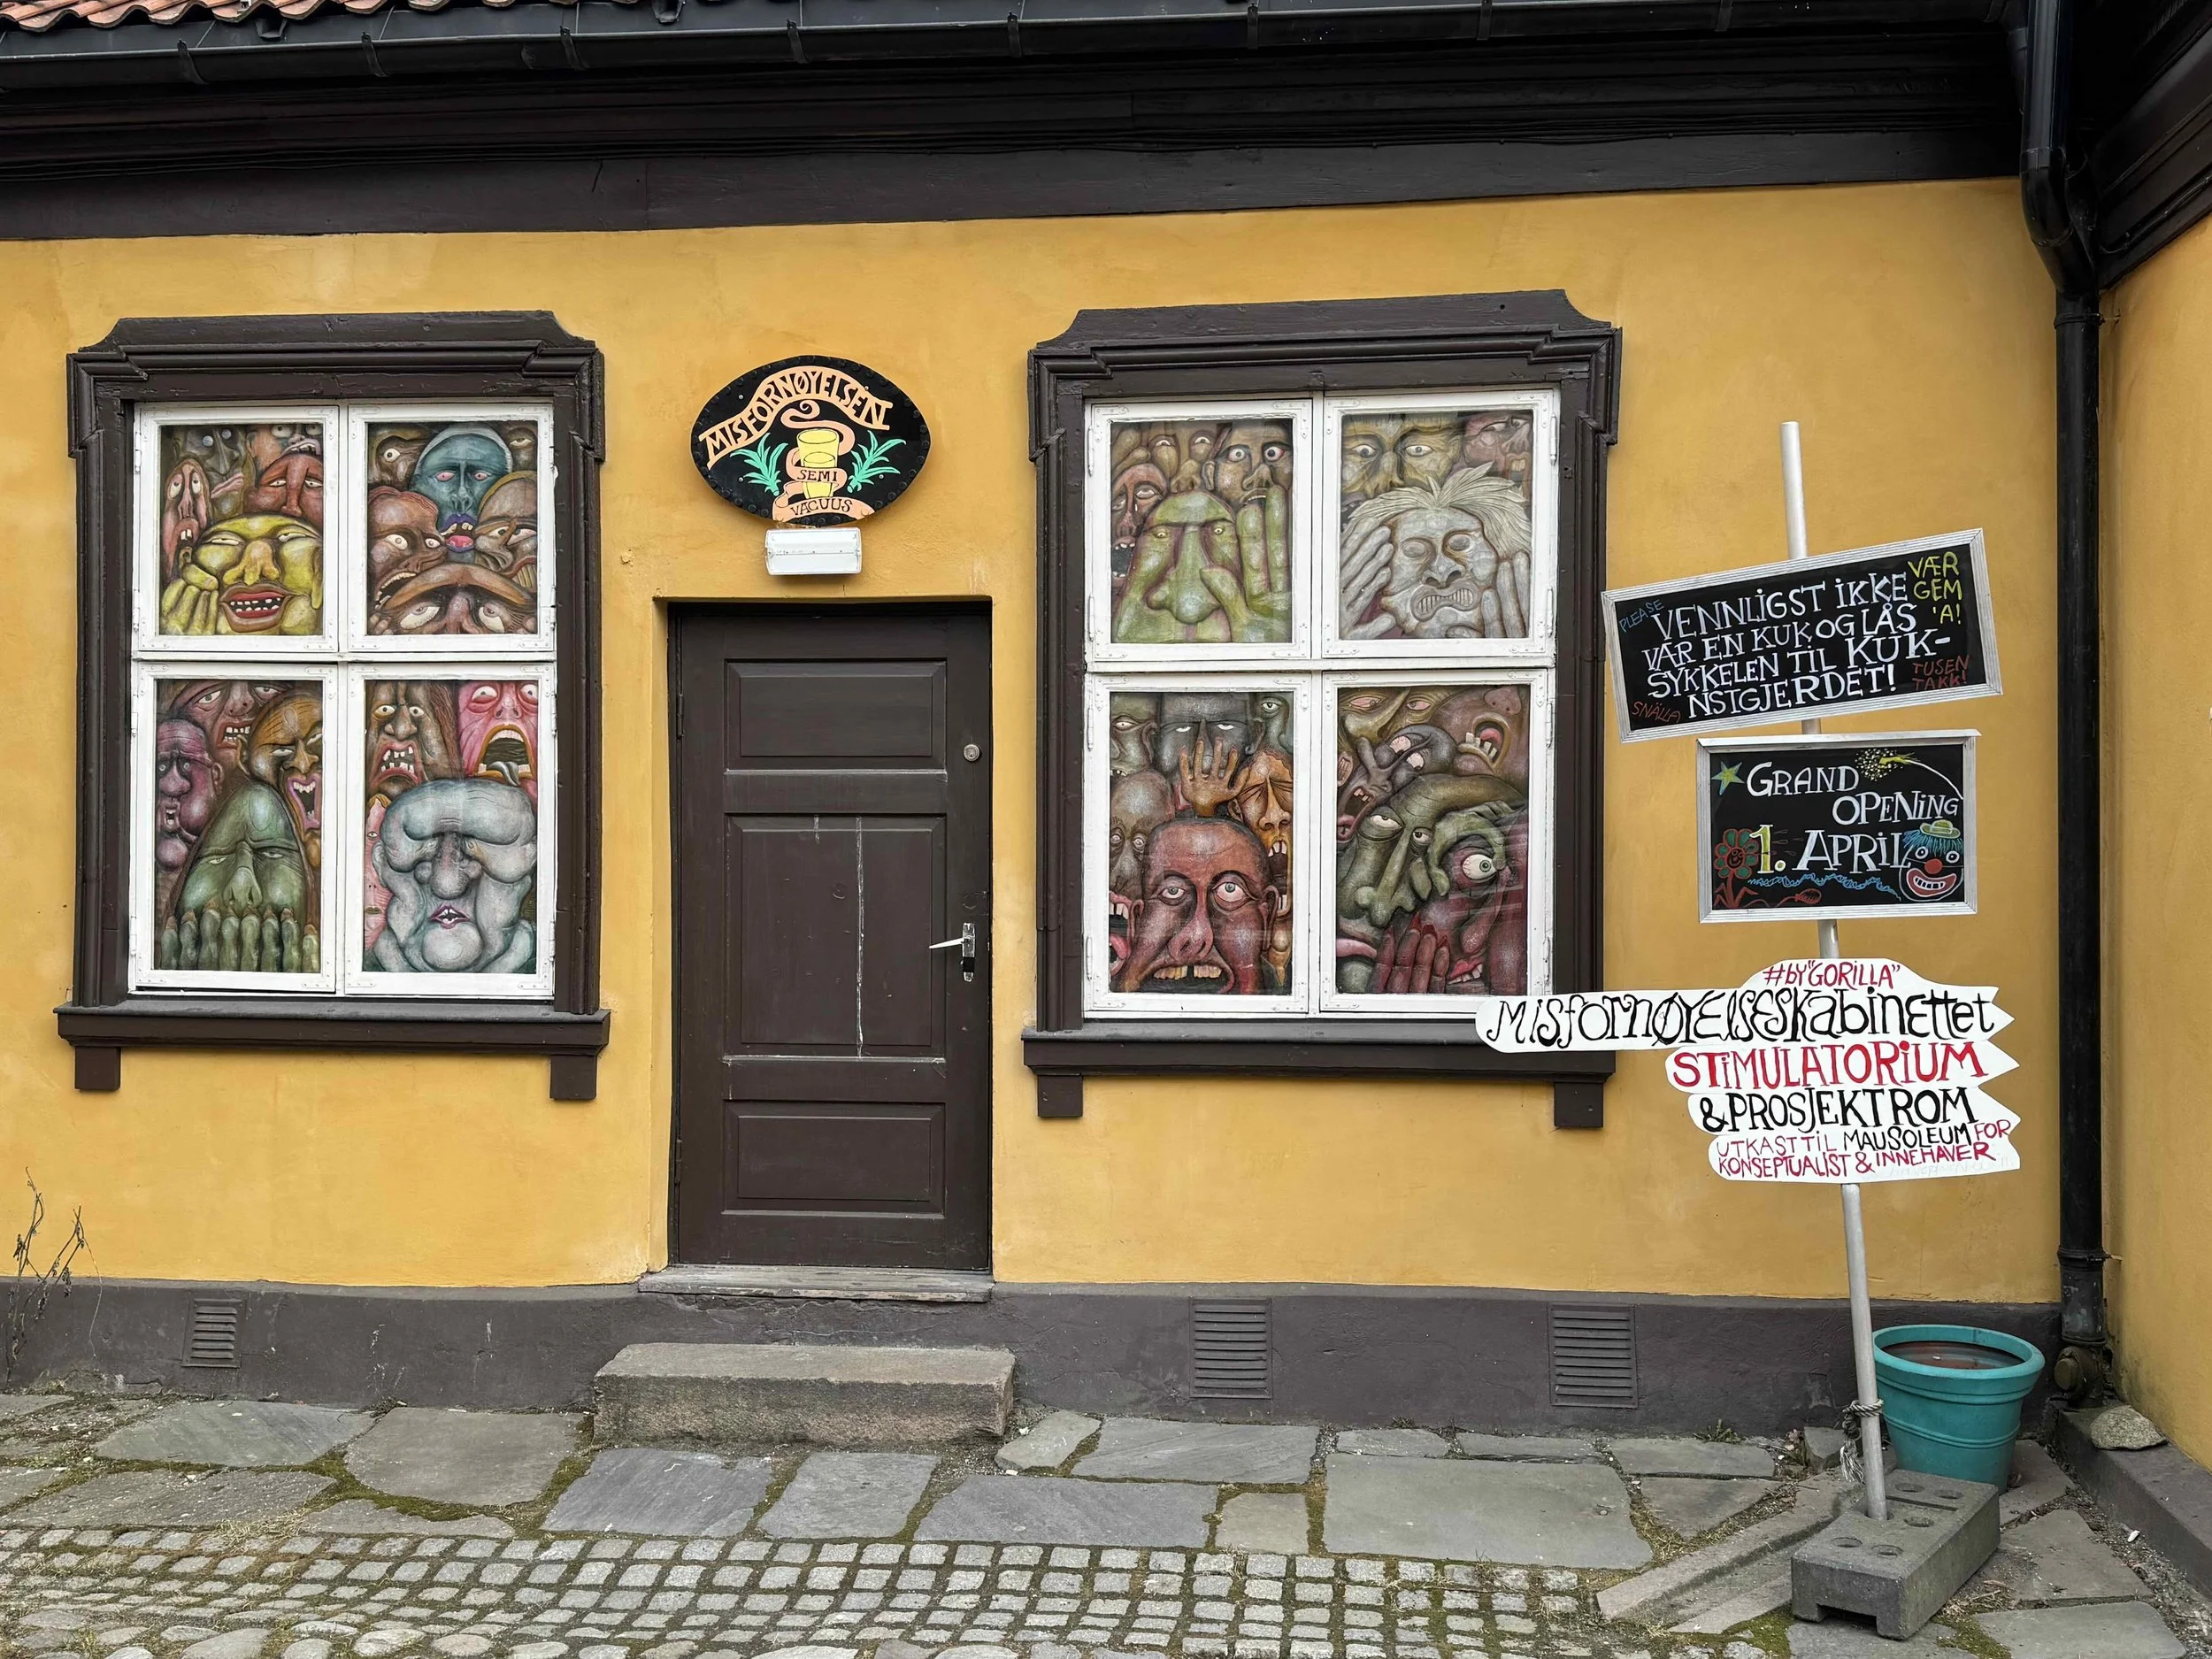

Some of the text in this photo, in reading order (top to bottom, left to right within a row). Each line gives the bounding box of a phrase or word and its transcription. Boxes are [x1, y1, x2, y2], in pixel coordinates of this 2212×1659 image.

[699, 366, 893, 470] MISFORNØYELSEN
[796, 469, 838, 482] SEMI
[789, 498, 853, 516] VACUUS
[1908, 551, 1960, 578] VÆR
[1913, 579, 1962, 602] GEM
[1619, 599, 1664, 633] PLEASE
[1701, 633, 1745, 662] EN
[1751, 621, 1812, 652] KUK
[1816, 613, 1855, 639] OG
[1861, 603, 1917, 636] LÅS
[1647, 650, 1778, 698] SYKKELEN
[1845, 628, 1951, 670] KUK-
[1911, 670, 1968, 691] TAKK!
[1912, 655, 1970, 676] TUSEN
[1687, 664, 1897, 719] NSTGJERDET!
[1632, 702, 1681, 724] SNÄLLA
[1747, 761, 1860, 797] GRAND
[1749, 824, 1786, 874] 1.
[1717, 1135, 1797, 1159] UTKAST
[1843, 1122, 1972, 1152] MAUSOLEUM
[1974, 1118, 2011, 1141] FOR
[1718, 1151, 1851, 1179] KONSEPTUALIST
[1855, 1151, 1875, 1174] &
[1876, 1141, 1997, 1167] INNEHAVER
